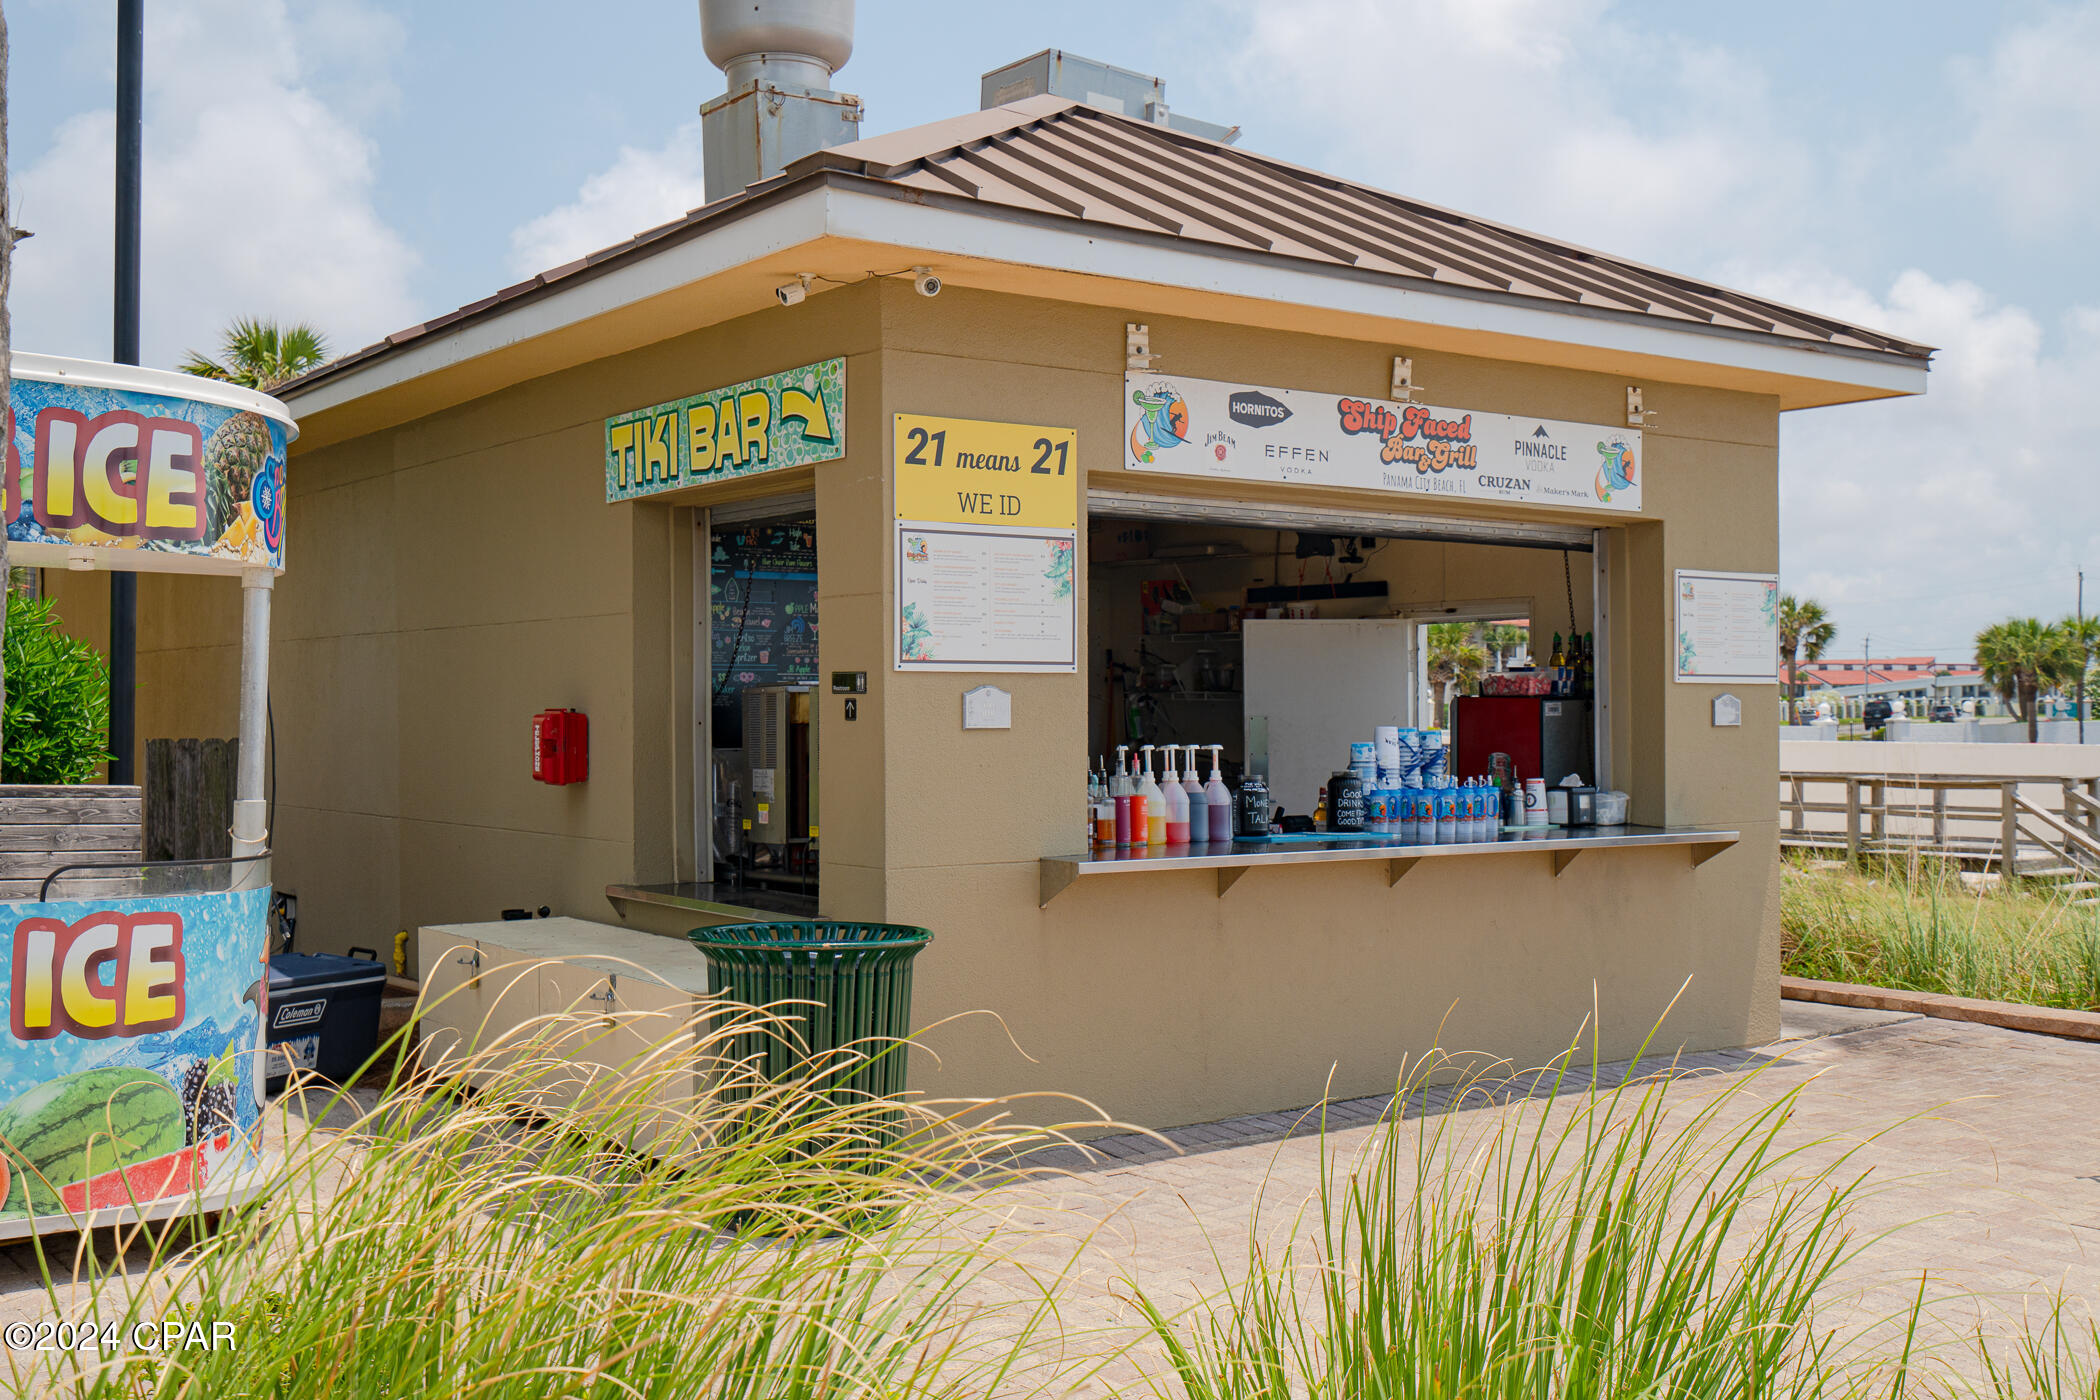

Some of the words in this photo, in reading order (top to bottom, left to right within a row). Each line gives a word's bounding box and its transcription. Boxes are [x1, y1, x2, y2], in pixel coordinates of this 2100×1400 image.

[1232, 401, 1285, 418] HORNITOS
[1339, 399, 1397, 441] Ship
[1401, 407, 1471, 441] Faced
[611, 410, 678, 488] TIKI
[687, 390, 770, 474] BAR
[905, 427, 946, 467] 21
[956, 451, 1022, 472] means
[1031, 438, 1069, 475] 21
[1265, 444, 1329, 463] EFFEN
[1382, 434, 1424, 463] Bar
[1417, 454, 1431, 473] &
[1428, 441, 1476, 472] Grill
[1514, 440, 1567, 460] PINNACLE
[40, 414, 201, 533] ICE
[1280, 466, 1312, 474] VODKA
[1525, 460, 1555, 473] VODKA
[1383, 472, 1412, 488] PANAMA
[1459, 480, 1466, 493] FL
[1478, 475, 1531, 490] CRUZAN
[1543, 487, 1570, 496] Maker's
[957, 492, 993, 514] WE
[999, 494, 1021, 515] ID
[17, 917, 181, 1034] ICE
[280, 1007, 314, 1021] Coleman
